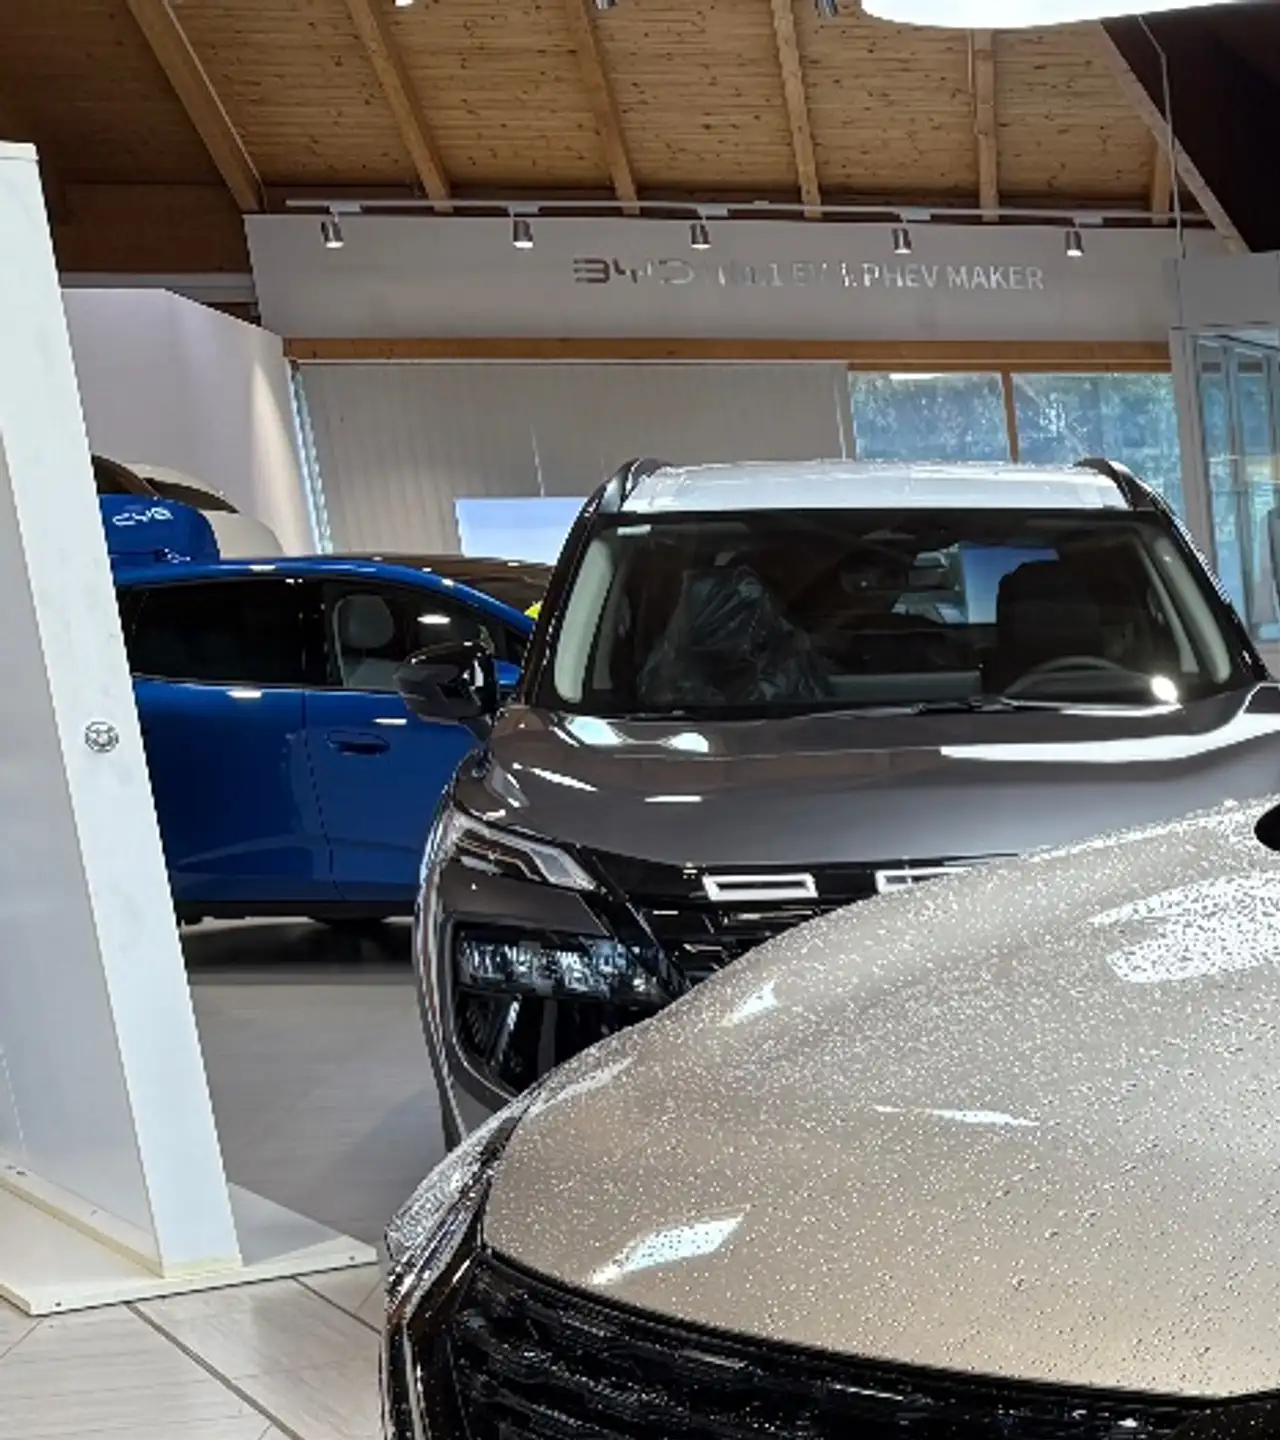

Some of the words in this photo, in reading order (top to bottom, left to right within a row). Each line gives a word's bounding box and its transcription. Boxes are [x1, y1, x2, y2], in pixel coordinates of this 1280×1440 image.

[573, 258, 695, 284] BYD
[861, 262, 939, 289] PHEV
[946, 264, 1044, 290] MAKER
